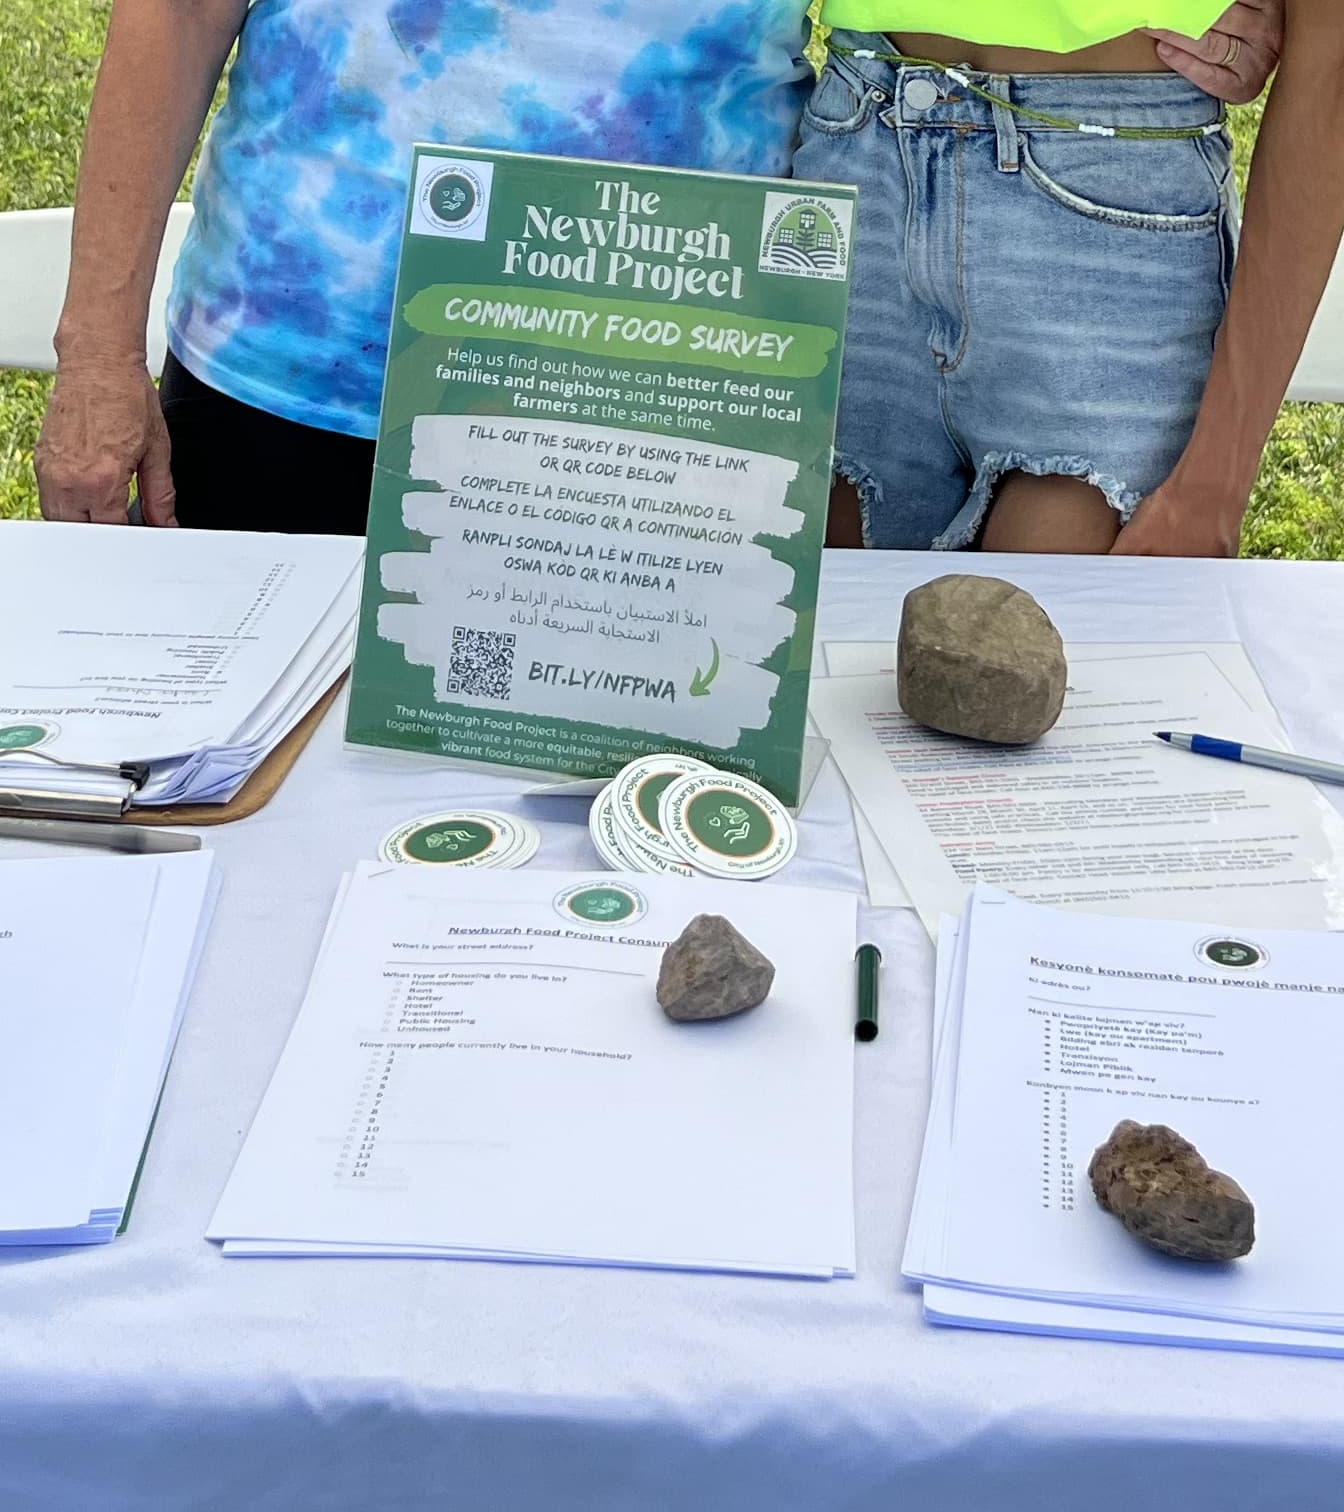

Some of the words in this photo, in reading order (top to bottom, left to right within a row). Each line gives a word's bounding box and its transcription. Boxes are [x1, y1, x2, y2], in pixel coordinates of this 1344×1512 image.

[595, 180, 660, 214] The
[521, 204, 730, 262] Newburgh
[501, 239, 596, 283] Food
[604, 251, 744, 300] Project
[444, 297, 599, 338] COMMUNITY
[604, 314, 681, 345] FOOD
[688, 324, 794, 361] SURVEY
[435, 363, 499, 385] families
[503, 375, 535, 389] and
[538, 378, 620, 399] neighbors
[624, 389, 654, 403] and
[658, 394, 724, 413] support
[728, 402, 757, 416] our
[761, 403, 801, 422] local
[447, 347, 481, 367] Help
[486, 354, 503, 366] us
[508, 353, 537, 370] find
[541, 361, 568, 374] out
[571, 360, 605, 378] how
[608, 369, 630, 381] we
[634, 372, 661, 385] can
[666, 372, 719, 392] better
[723, 379, 759, 397] feed
[763, 387, 794, 401] our
[513, 392, 578, 413] farmers
[581, 403, 597, 416] at
[601, 403, 626, 419] the
[630, 410, 672, 425] same
[677, 414, 715, 431] time.
[468, 424, 498, 439] FILL
[502, 429, 530, 445] OUT
[532, 432, 558, 447] THE
[561, 436, 613, 455] SURVEY
[616, 442, 636, 458] BY
[639, 446, 682, 464] USING
[685, 451, 712, 466] THE
[715, 455, 749, 472] LINK
[539, 455, 558, 472] OR
[562, 458, 581, 474] QR
[585, 461, 622, 477] CODE
[625, 466, 676, 484] BELOW
[460, 475, 530, 495] COMPLETE
[534, 484, 552, 500] LA
[556, 487, 625, 509] ENCUESTA
[631, 497, 713, 518] UTILIZANDO
[717, 508, 735, 522] EL
[528, 660, 675, 703] BIT.LY/NFPWA
[700, 778, 732, 788] Food
[734, 783, 778, 816] Project
[672, 782, 701, 831] Newburgh
[681, 834, 699, 853] The
[447, 927, 522, 937] Newburgh
[526, 928, 560, 937] Food
[565, 930, 614, 944] Project
